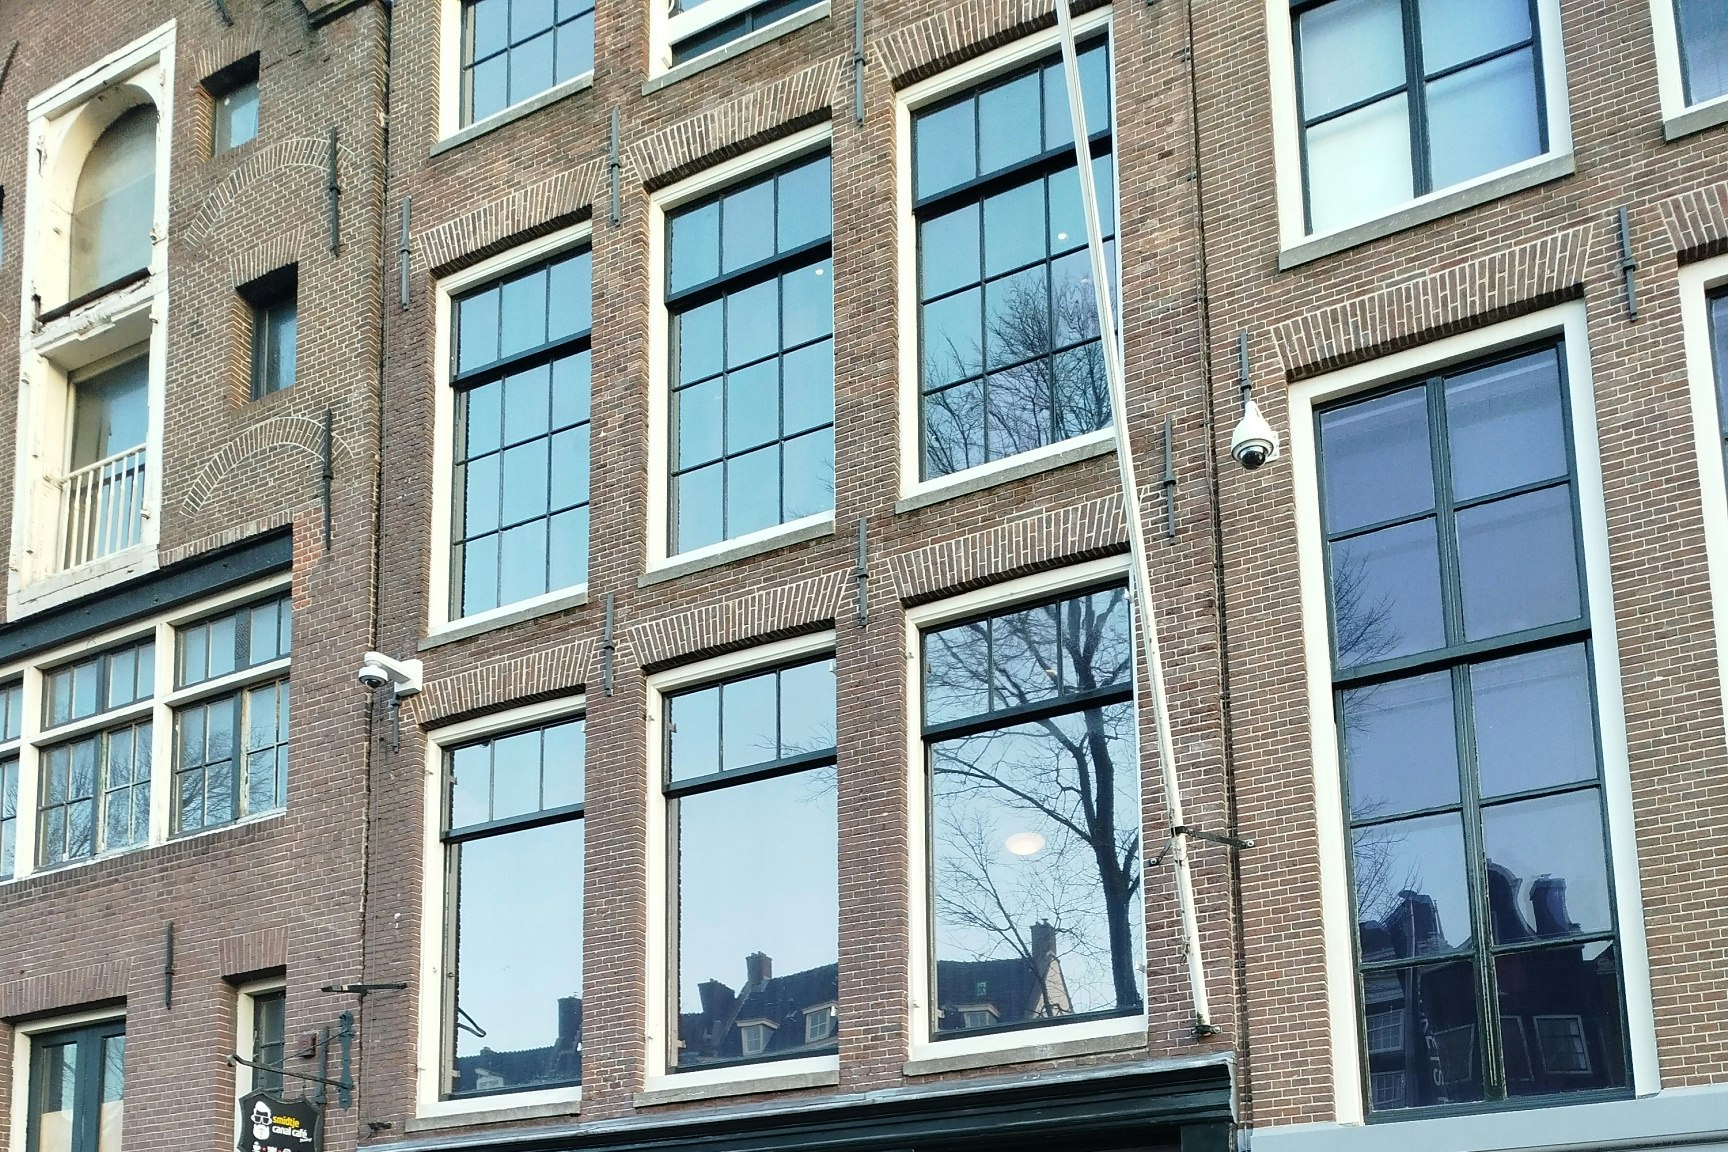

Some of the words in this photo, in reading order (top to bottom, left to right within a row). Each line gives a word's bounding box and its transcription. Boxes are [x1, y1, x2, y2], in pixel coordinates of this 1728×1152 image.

[272, 1115, 300, 1128] smidtje
[272, 1125, 291, 1136] canal
[292, 1128, 307, 1138] café
